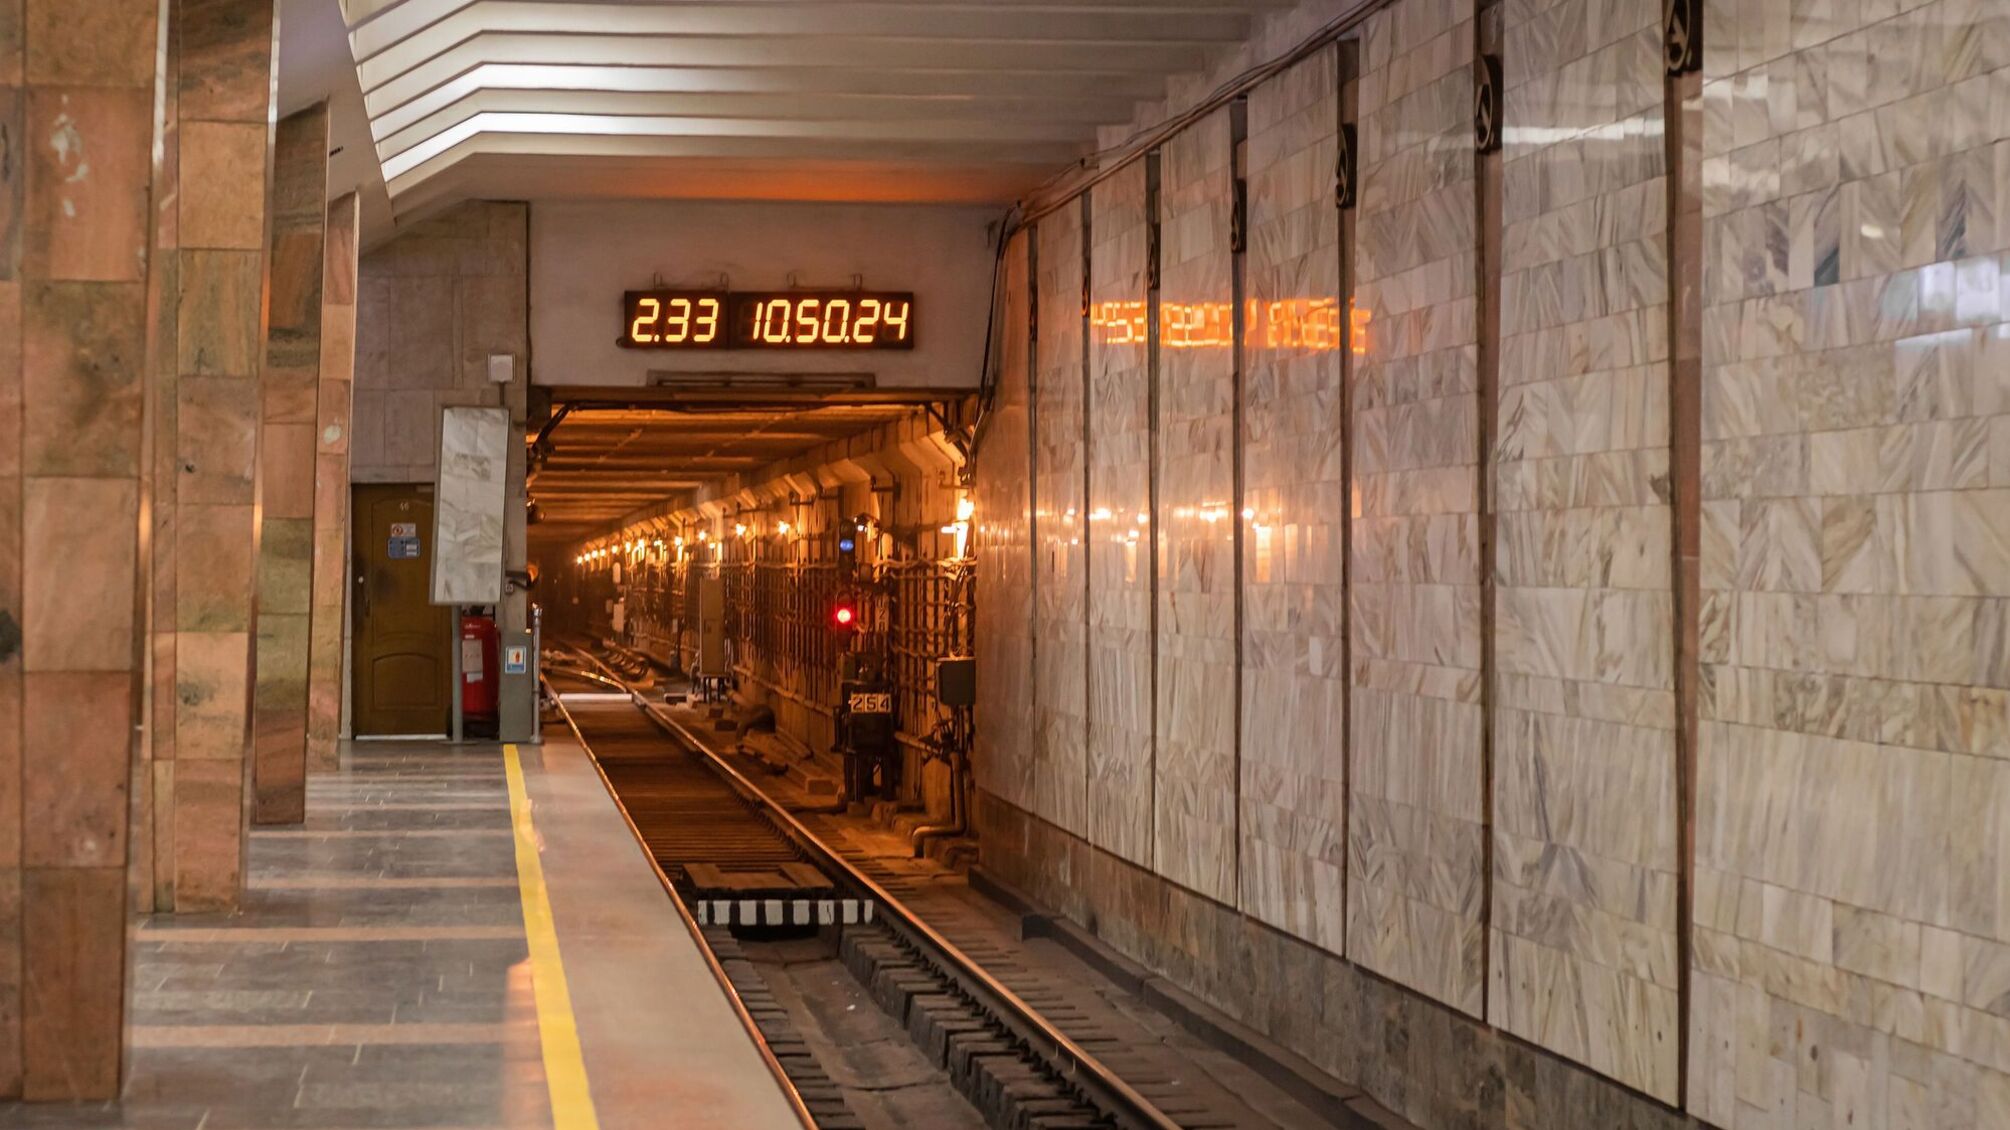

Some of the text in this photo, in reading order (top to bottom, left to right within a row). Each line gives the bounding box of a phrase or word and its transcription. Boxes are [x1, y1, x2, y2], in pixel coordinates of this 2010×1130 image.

[631, 298, 909, 344] 2.33 10.50.24
[851, 695, 890, 711] 254
